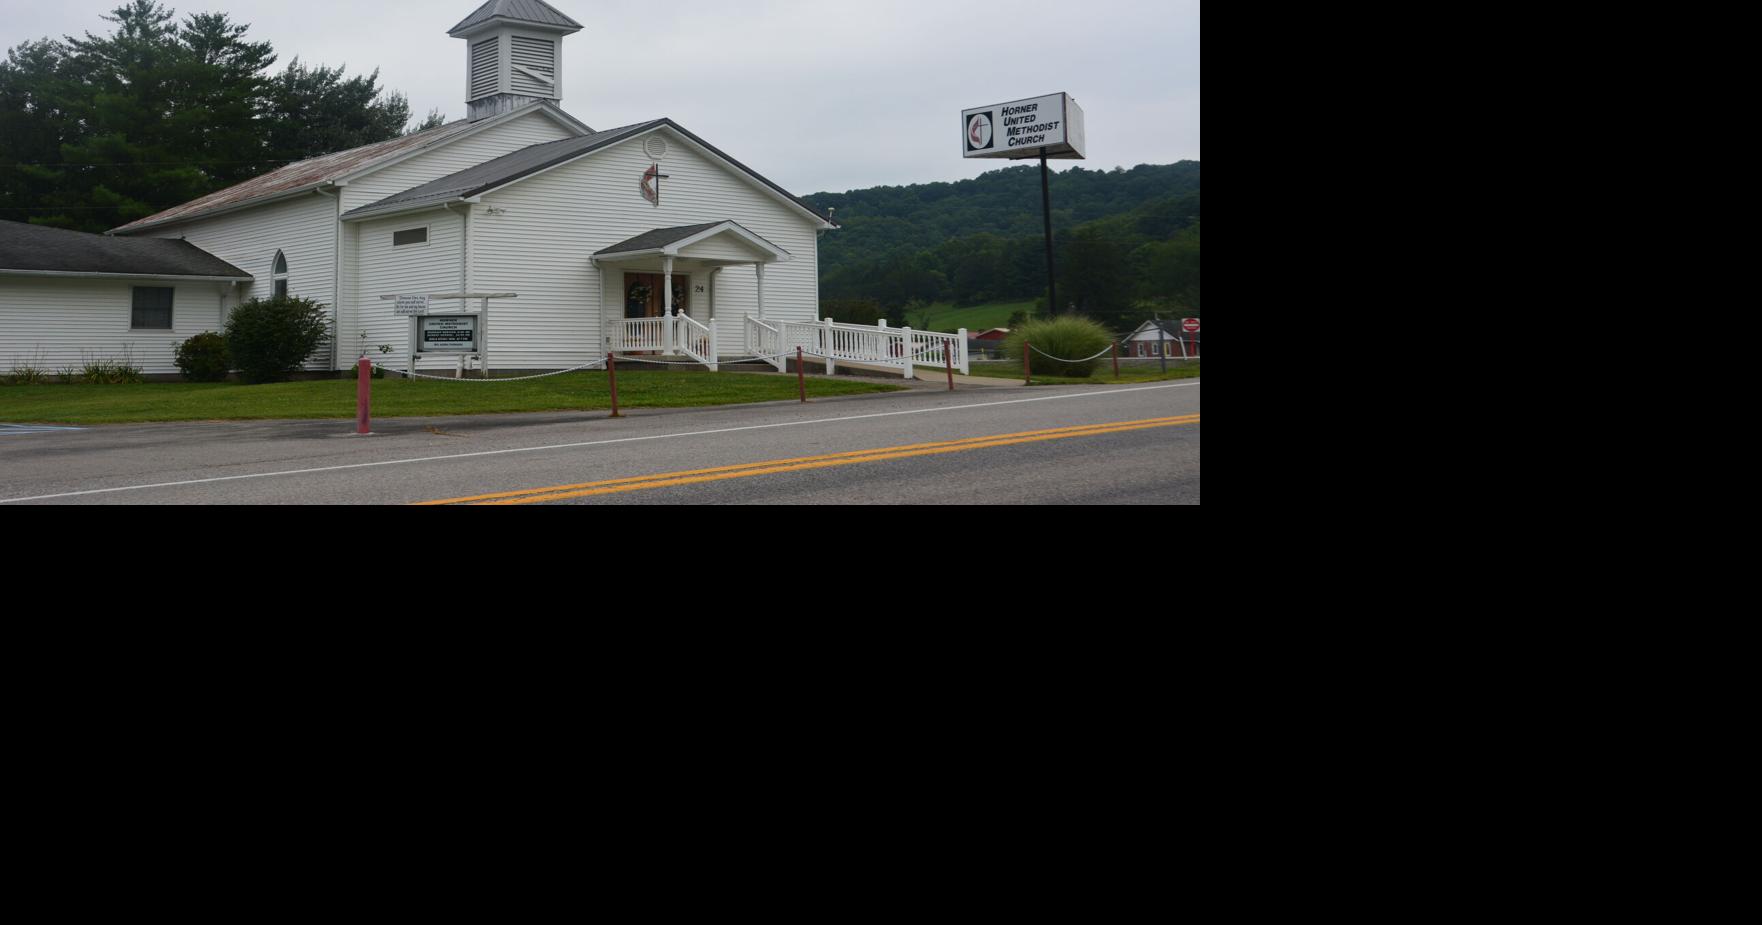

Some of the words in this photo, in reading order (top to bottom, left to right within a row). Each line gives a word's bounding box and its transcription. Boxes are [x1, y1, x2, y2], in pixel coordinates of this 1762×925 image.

[1001, 104, 1038, 116] HORNER
[1003, 114, 1036, 127] UNITED
[1007, 121, 1060, 137] METHODIST
[1008, 134, 1045, 147] CHURCH
[695, 285, 704, 293] 24
